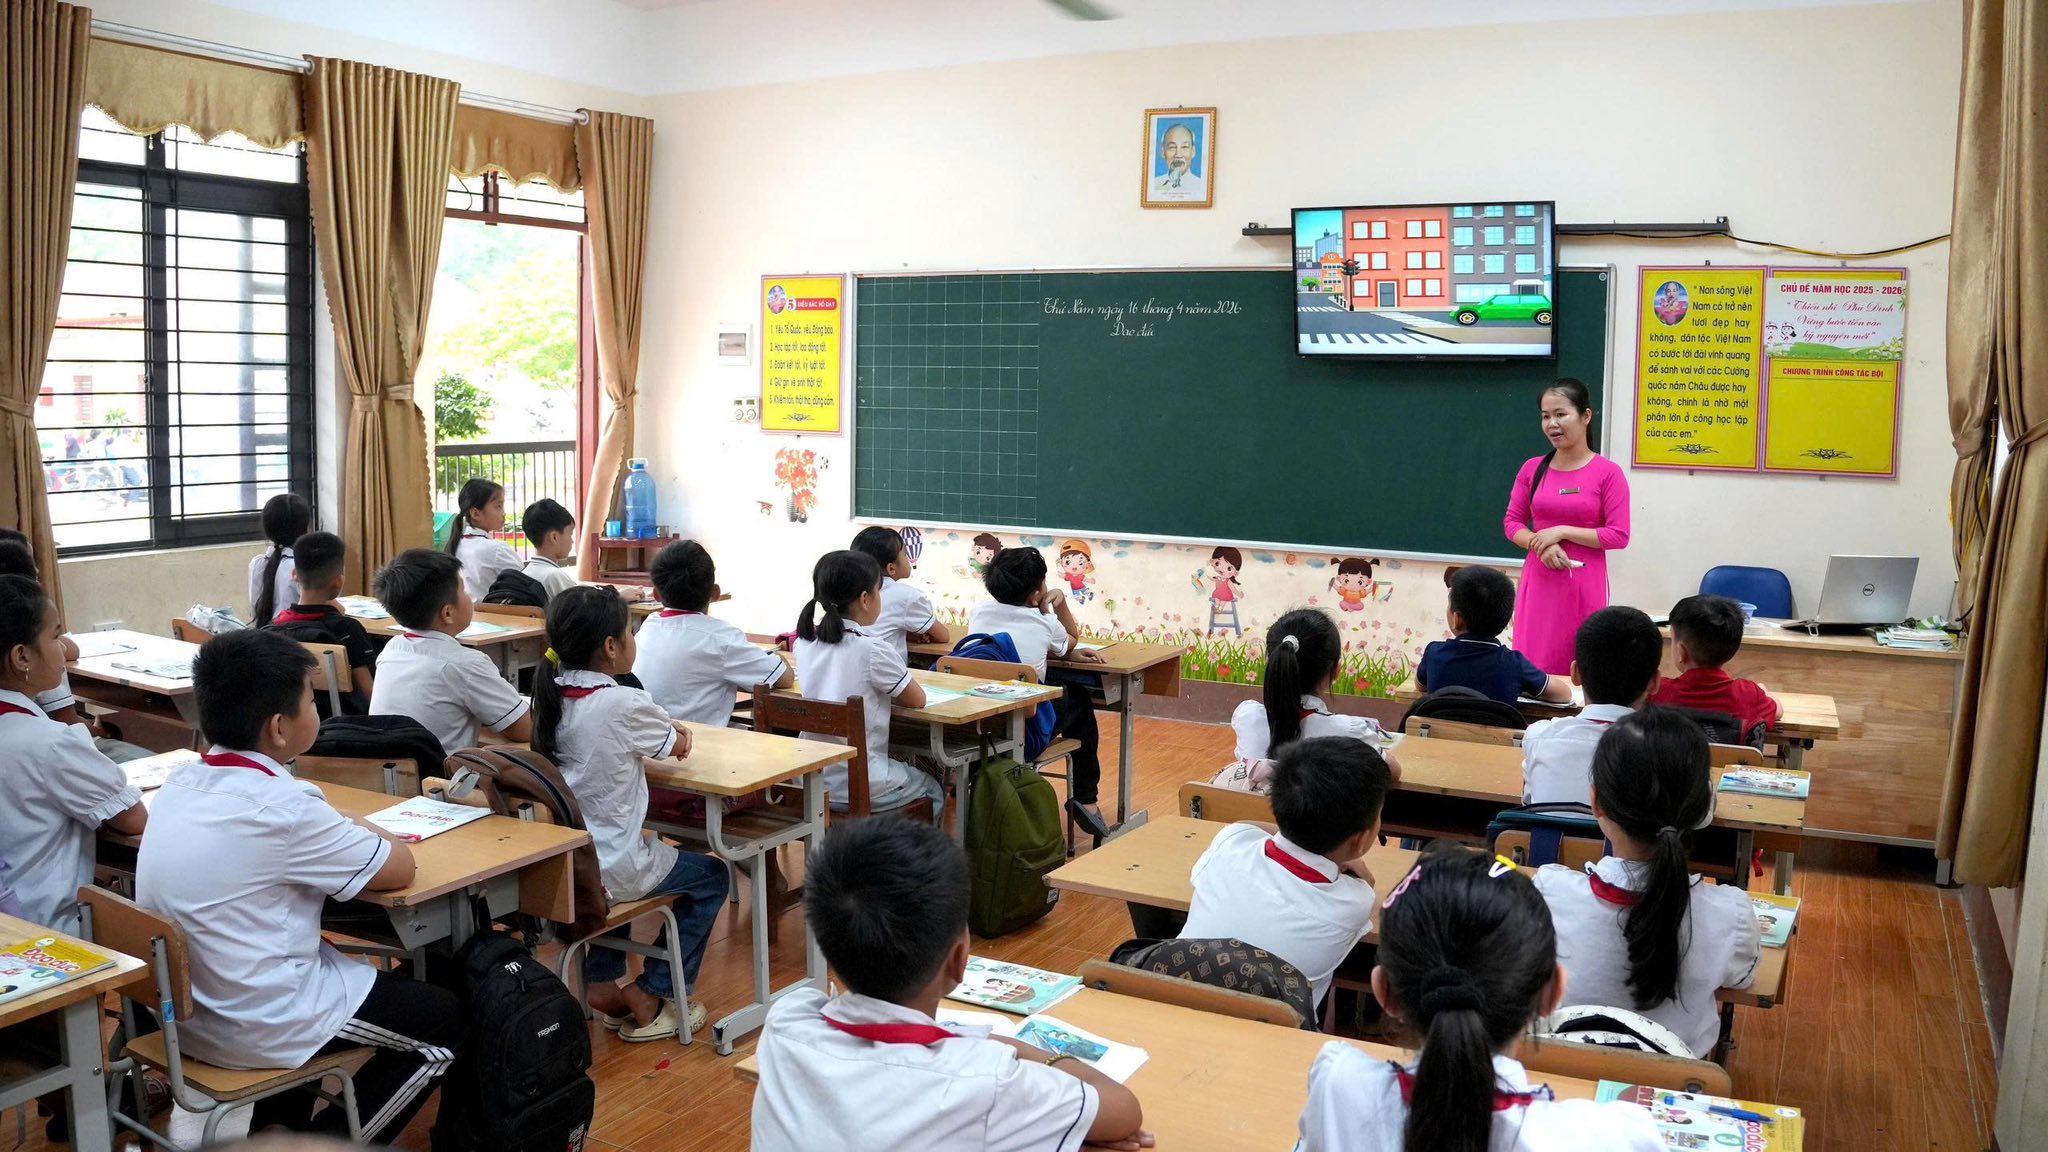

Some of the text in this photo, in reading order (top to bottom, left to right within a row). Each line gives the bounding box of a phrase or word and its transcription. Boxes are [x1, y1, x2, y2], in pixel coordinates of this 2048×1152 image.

[1700, 286, 1714, 295] Non
[1716, 286, 1735, 297] sông
[1738, 286, 1752, 296] Việt
[1781, 282, 1797, 293] CHỦ
[1800, 283, 1810, 293] ĐỀ
[1812, 284, 1832, 293] NĂM
[1834, 285, 1851, 295] HỌC
[1854, 286, 1873, 294] 2025
[1882, 286, 1902, 295] 2026
[788, 300, 794, 310] 5
[1129, 301, 1139, 314] 16
[1176, 301, 1184, 314] 4
[1186, 302, 1211, 314] năm
[1213, 300, 1242, 315] 2026
[1693, 300, 1752, 311] Nam có trở nên
[1692, 318, 1750, 329] tươi đẹp hay
[1681, 334, 1696, 342] dân
[1698, 334, 1711, 344] tộc
[1715, 334, 1730, 345] Việt
[1733, 335, 1751, 343] Nam
[1649, 349, 1751, 362] có bước tới đài vinh quang
[1648, 363, 1750, 378] để sánh vai với các Cường
[1814, 368, 1833, 376] TRÌNH
[1835, 368, 1854, 376] CÔNG
[1857, 369, 1869, 377] TÁC
[1872, 370, 1883, 378] ĐỘI
[1648, 380, 1667, 391] quốc
[1688, 382, 1708, 391] Châu
[1711, 382, 1730, 393] được
[1733, 383, 1747, 393] hay
[1678, 398, 1698, 406] chính
[1702, 398, 1709, 407] là
[1714, 399, 1729, 407] nhờ
[1734, 400, 1749, 409] một
[1646, 412, 1748, 427] phần lớn ở công học tập
[1646, 426, 1660, 437] của
[538, 1022, 560, 1038] FASHION
